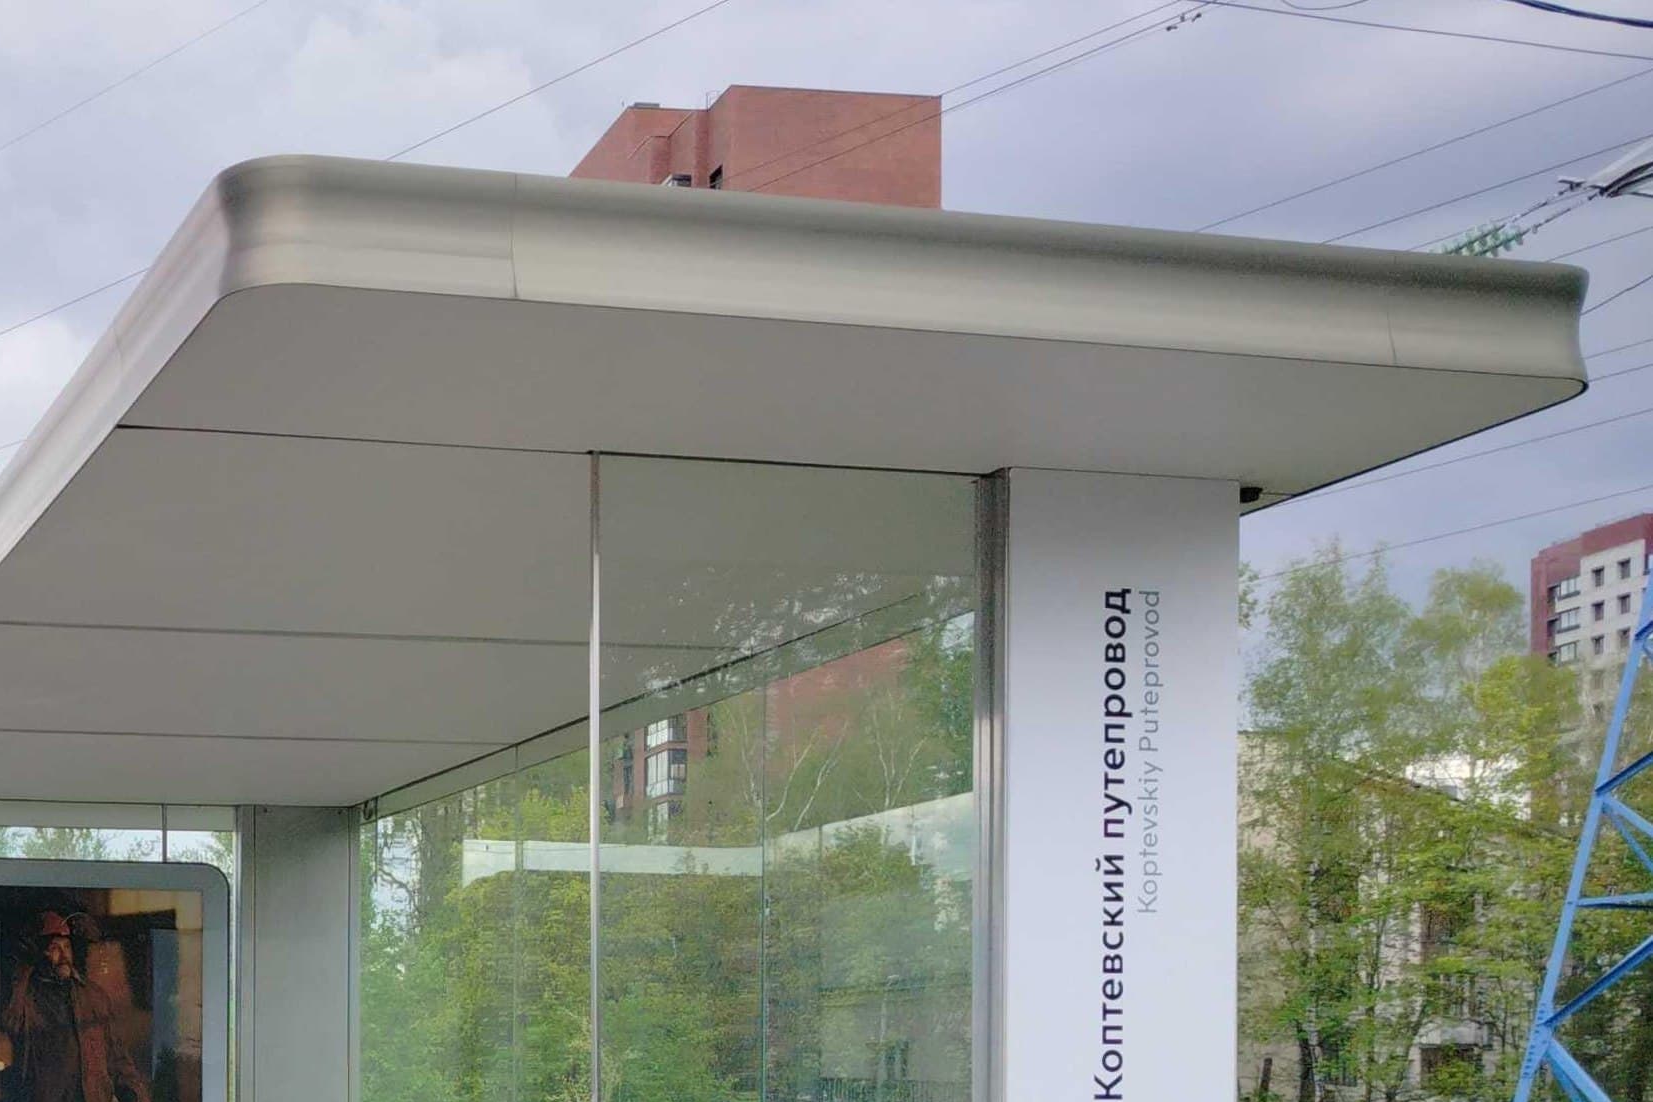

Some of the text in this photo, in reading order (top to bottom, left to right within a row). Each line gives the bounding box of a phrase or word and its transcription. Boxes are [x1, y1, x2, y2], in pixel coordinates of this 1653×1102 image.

[1094, 588, 1132, 1100] Коптевский путепровод
[1137, 590, 1164, 913] Koptevskiy Puteprovod
